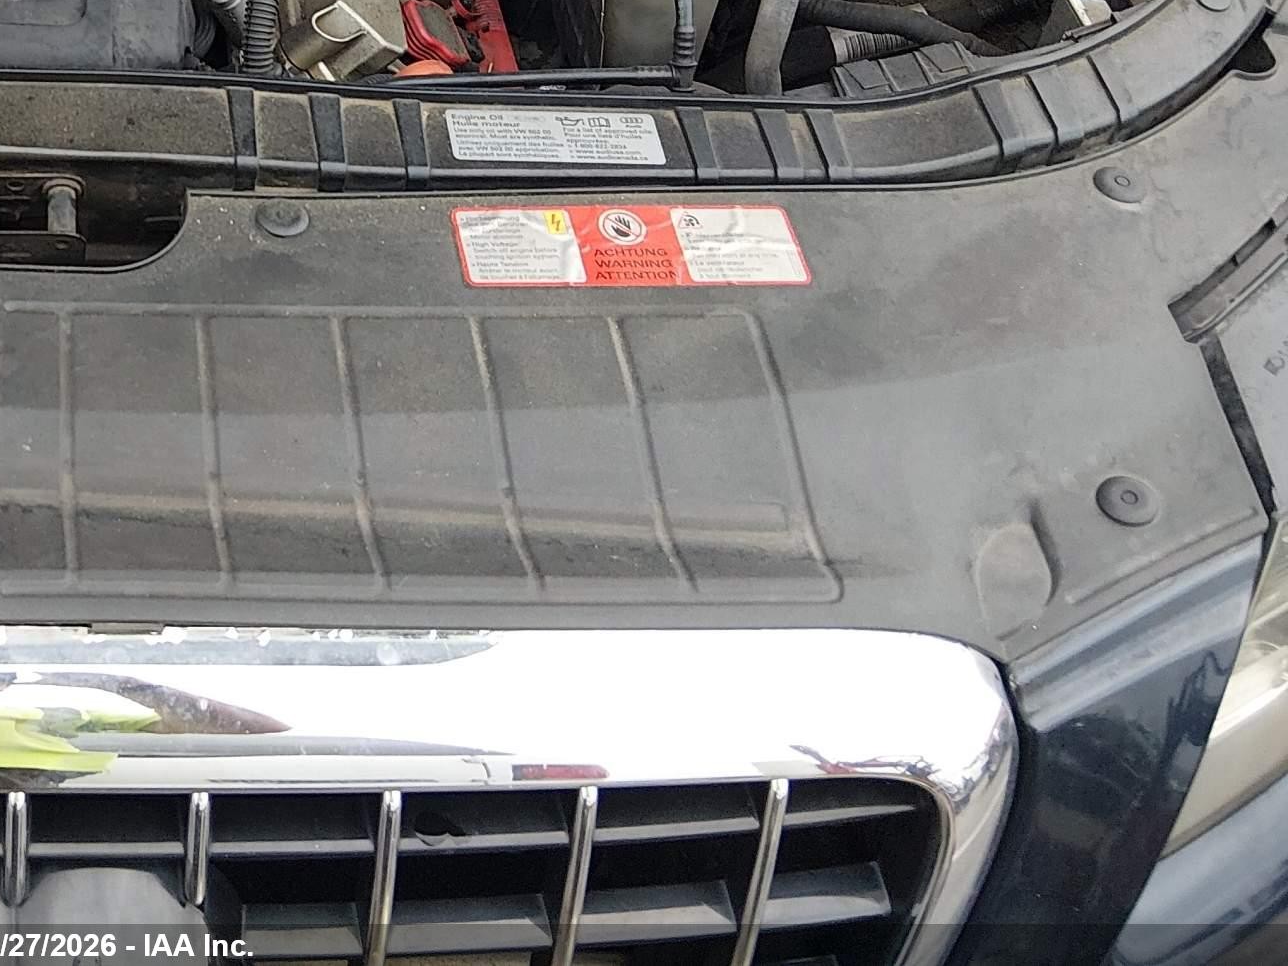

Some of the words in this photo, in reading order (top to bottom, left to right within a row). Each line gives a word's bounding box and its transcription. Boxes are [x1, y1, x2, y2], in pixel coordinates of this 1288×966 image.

[451, 114, 486, 122] Engine
[594, 247, 669, 257] ACHTUNG
[595, 259, 675, 269] WARNING
